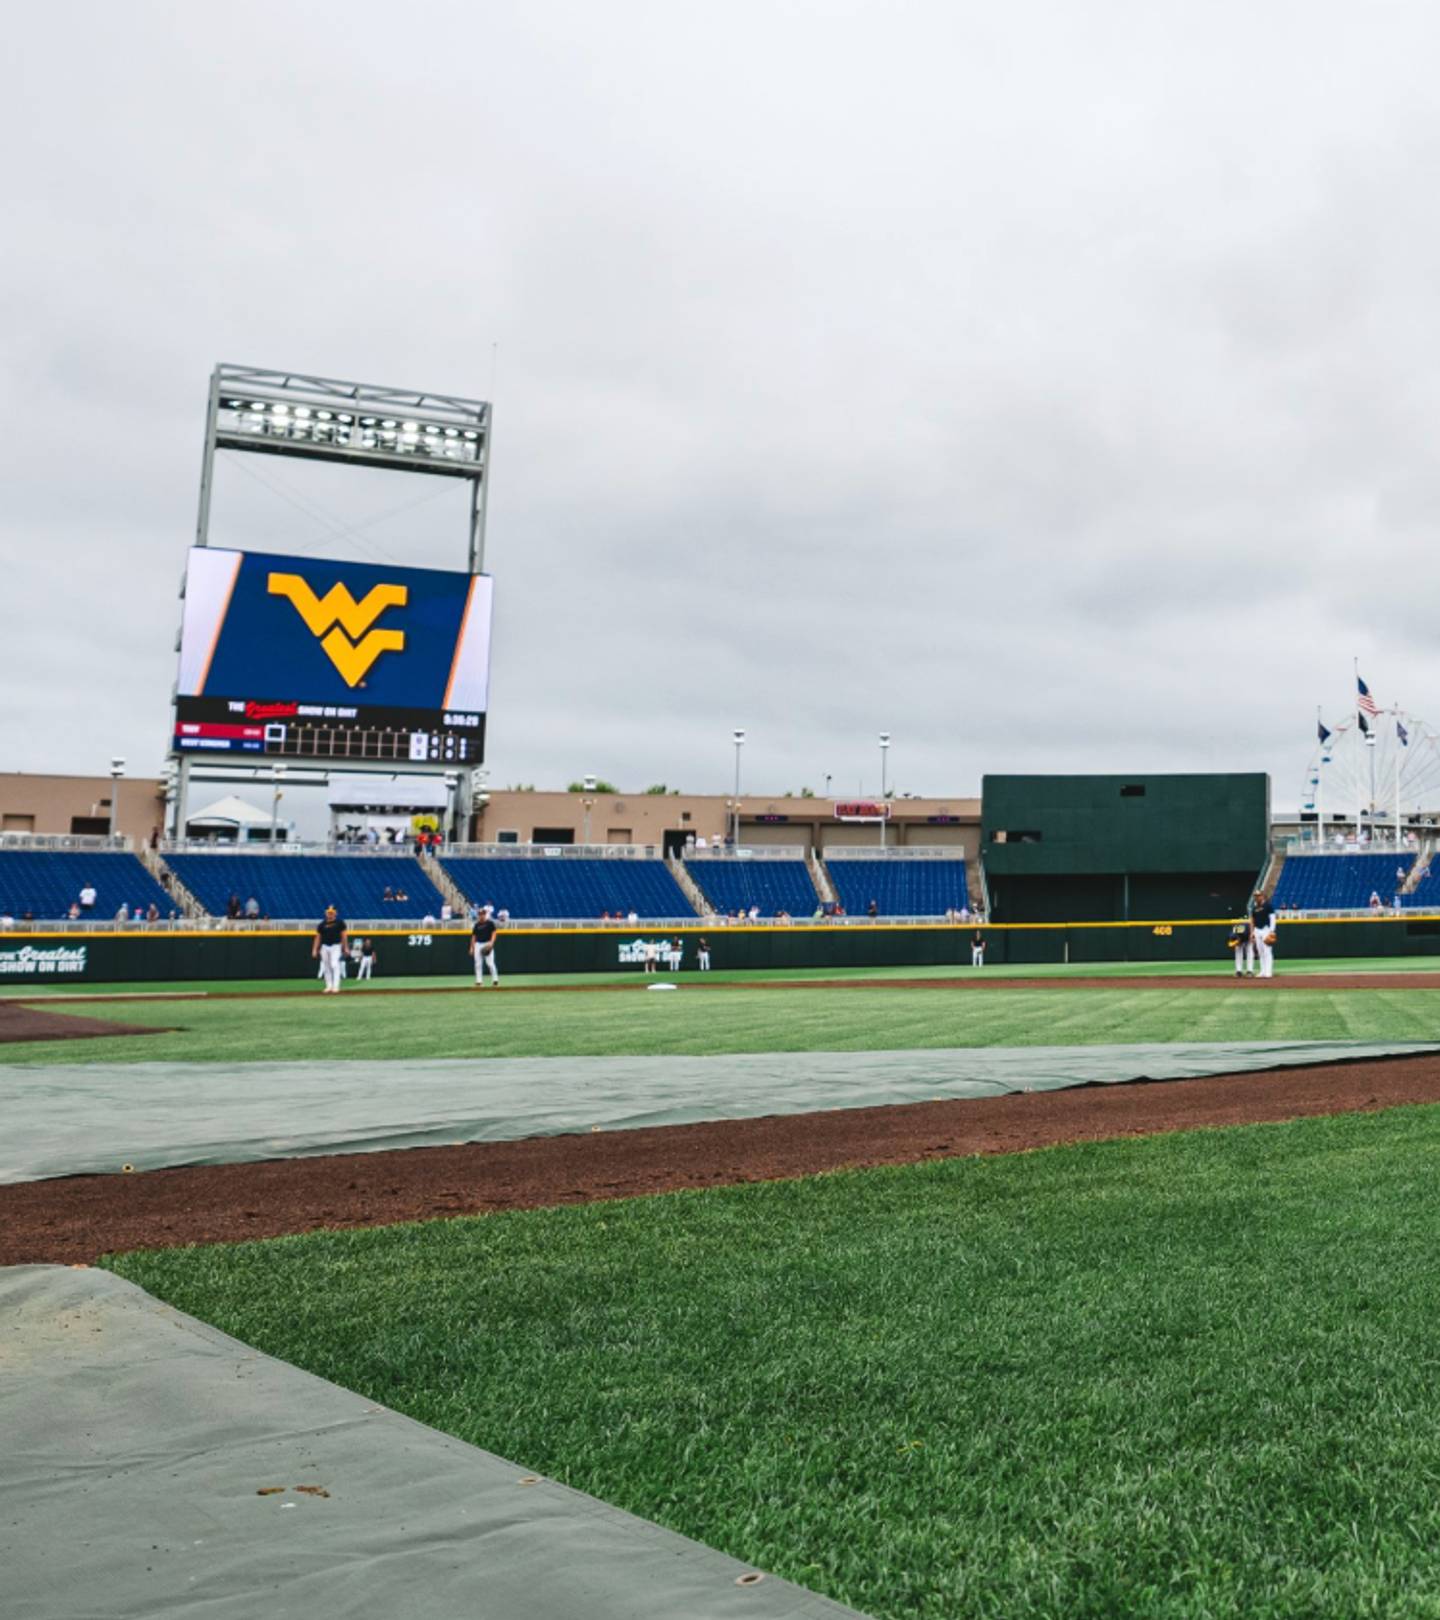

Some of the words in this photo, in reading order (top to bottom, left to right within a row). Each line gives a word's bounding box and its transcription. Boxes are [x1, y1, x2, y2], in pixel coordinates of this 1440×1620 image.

[408, 935, 432, 946] 375
[18, 945, 87, 963] Greatest
[0, 961, 37, 972] SHOW
[38, 961, 56, 972] ON
[57, 960, 87, 972] DIRT
